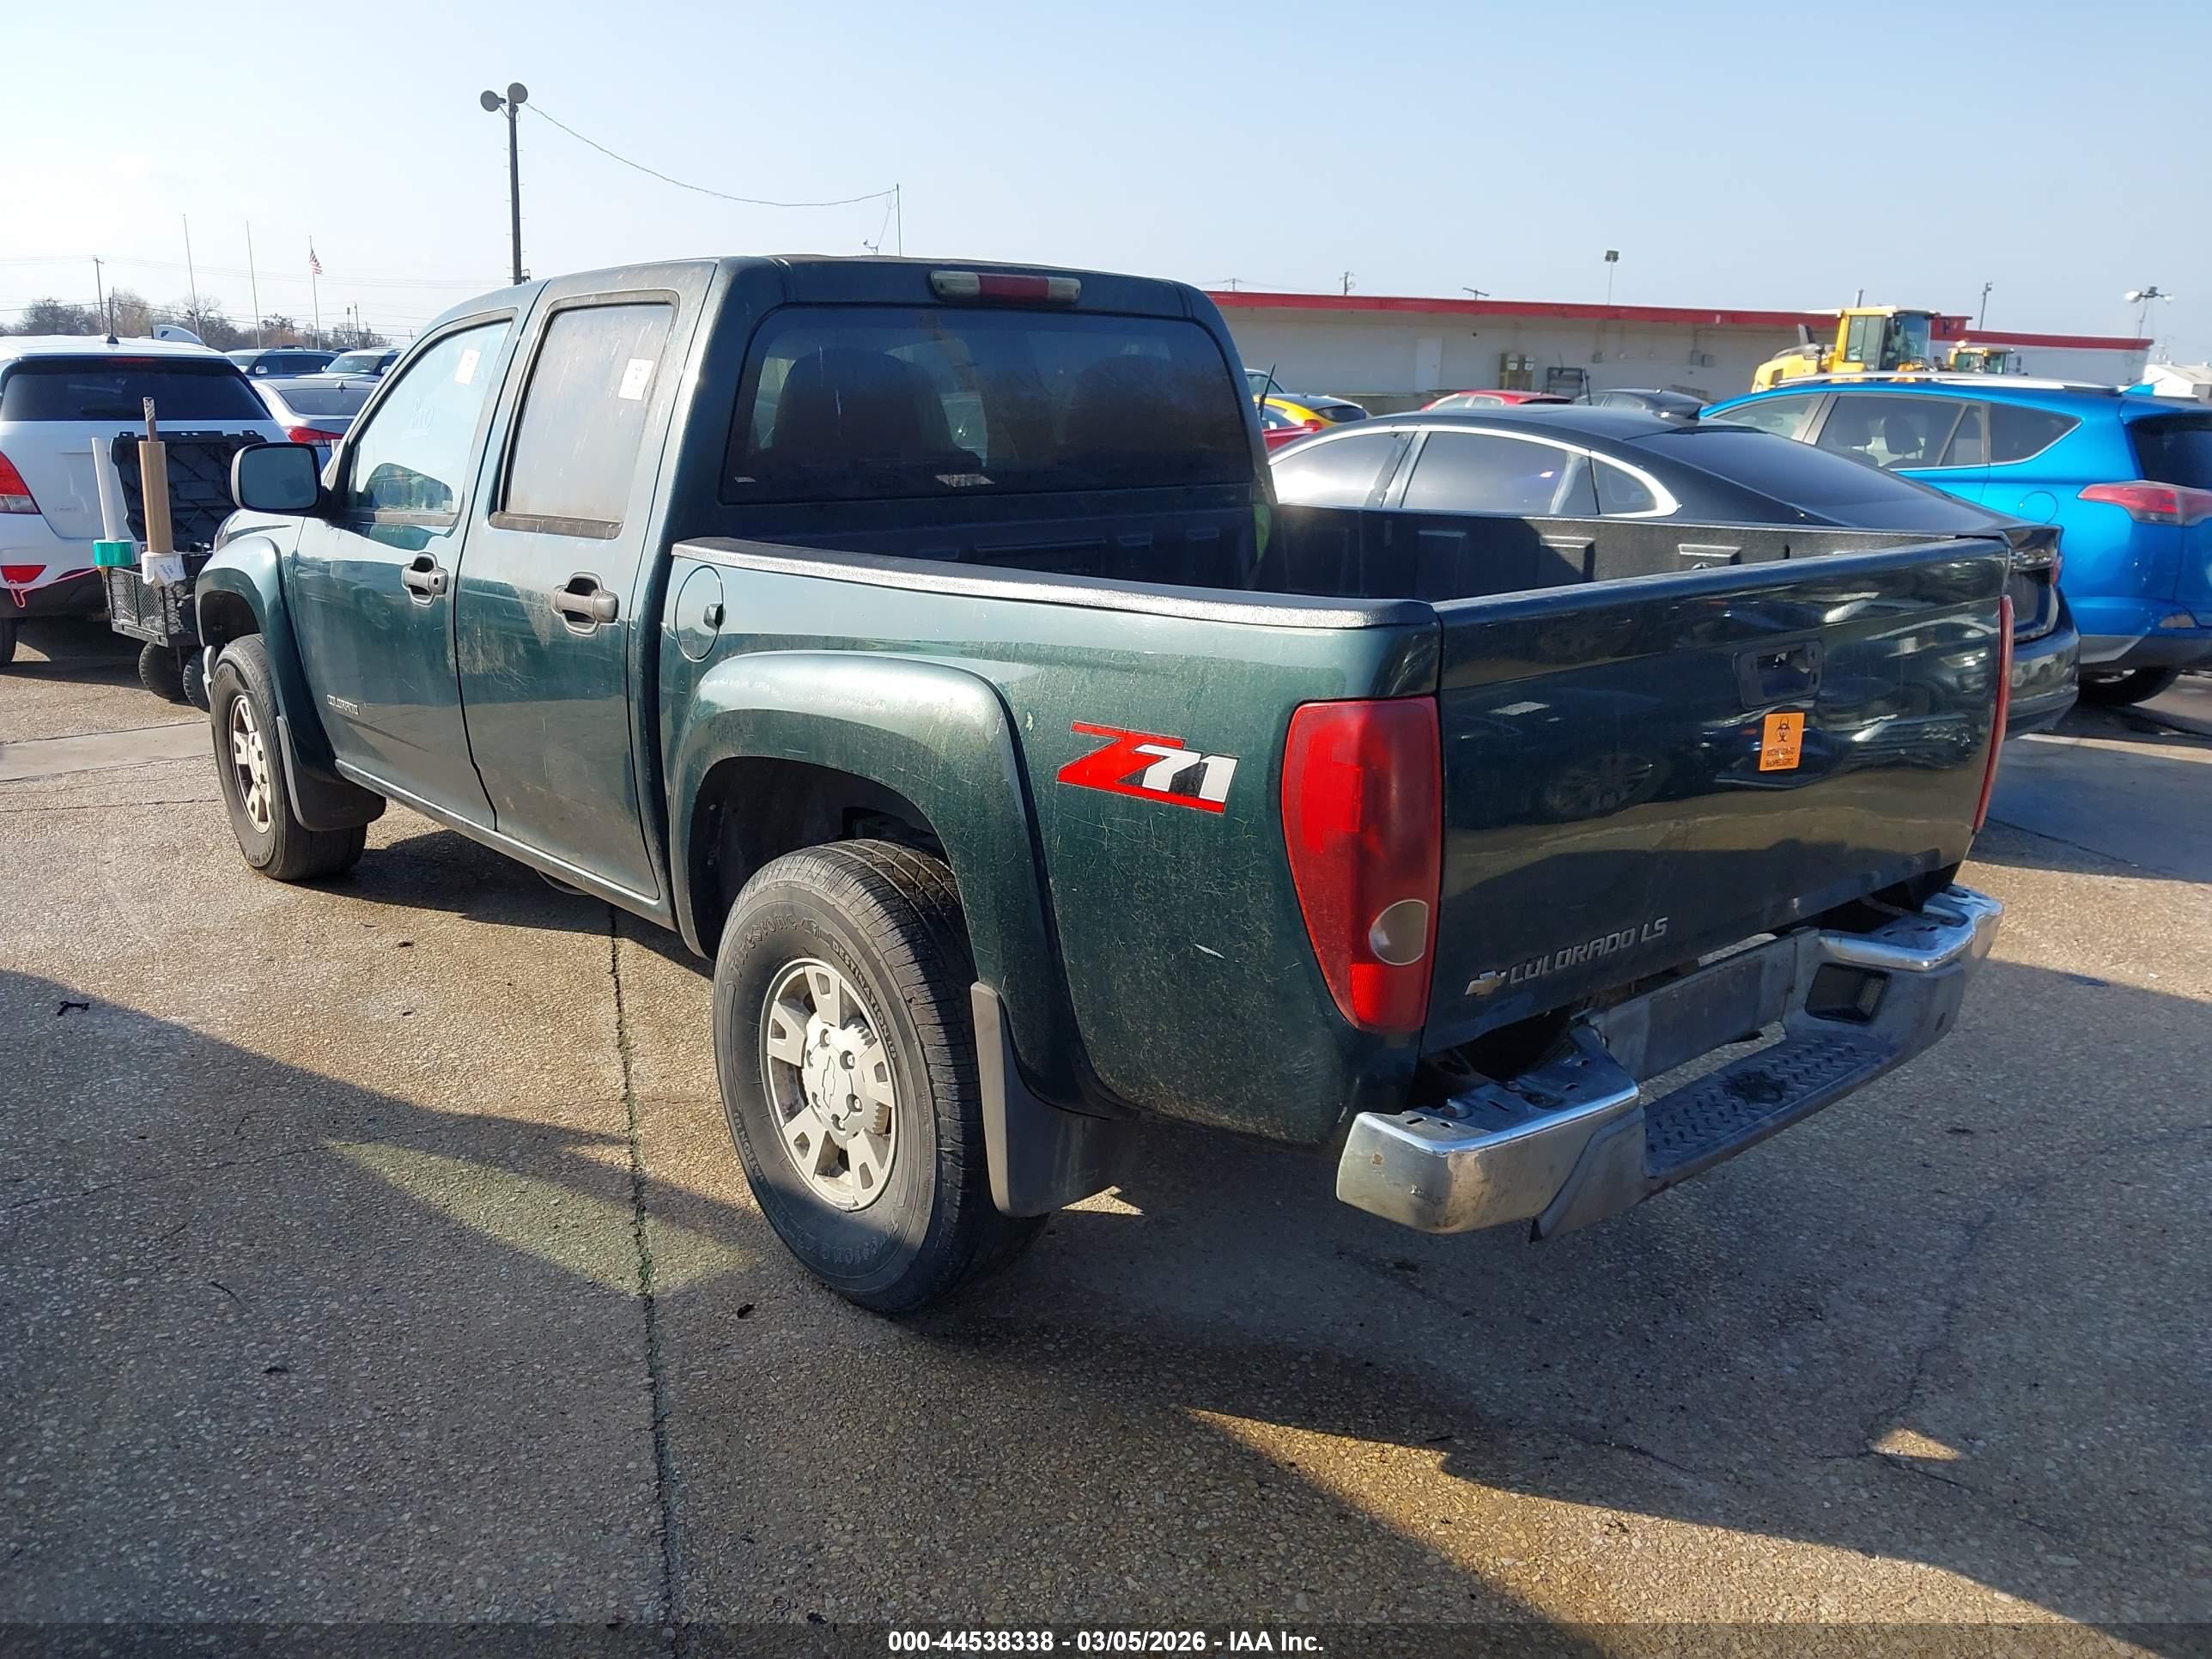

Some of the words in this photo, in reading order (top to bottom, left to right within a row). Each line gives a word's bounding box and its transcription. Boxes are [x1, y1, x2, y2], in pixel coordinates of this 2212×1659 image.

[1057, 720, 1240, 815] Z71
[730, 913, 798, 978] Firestone
[1510, 928, 1635, 985] COLORADO
[1641, 917, 1668, 943] LS
[831, 939, 890, 1038] DESTINATION
